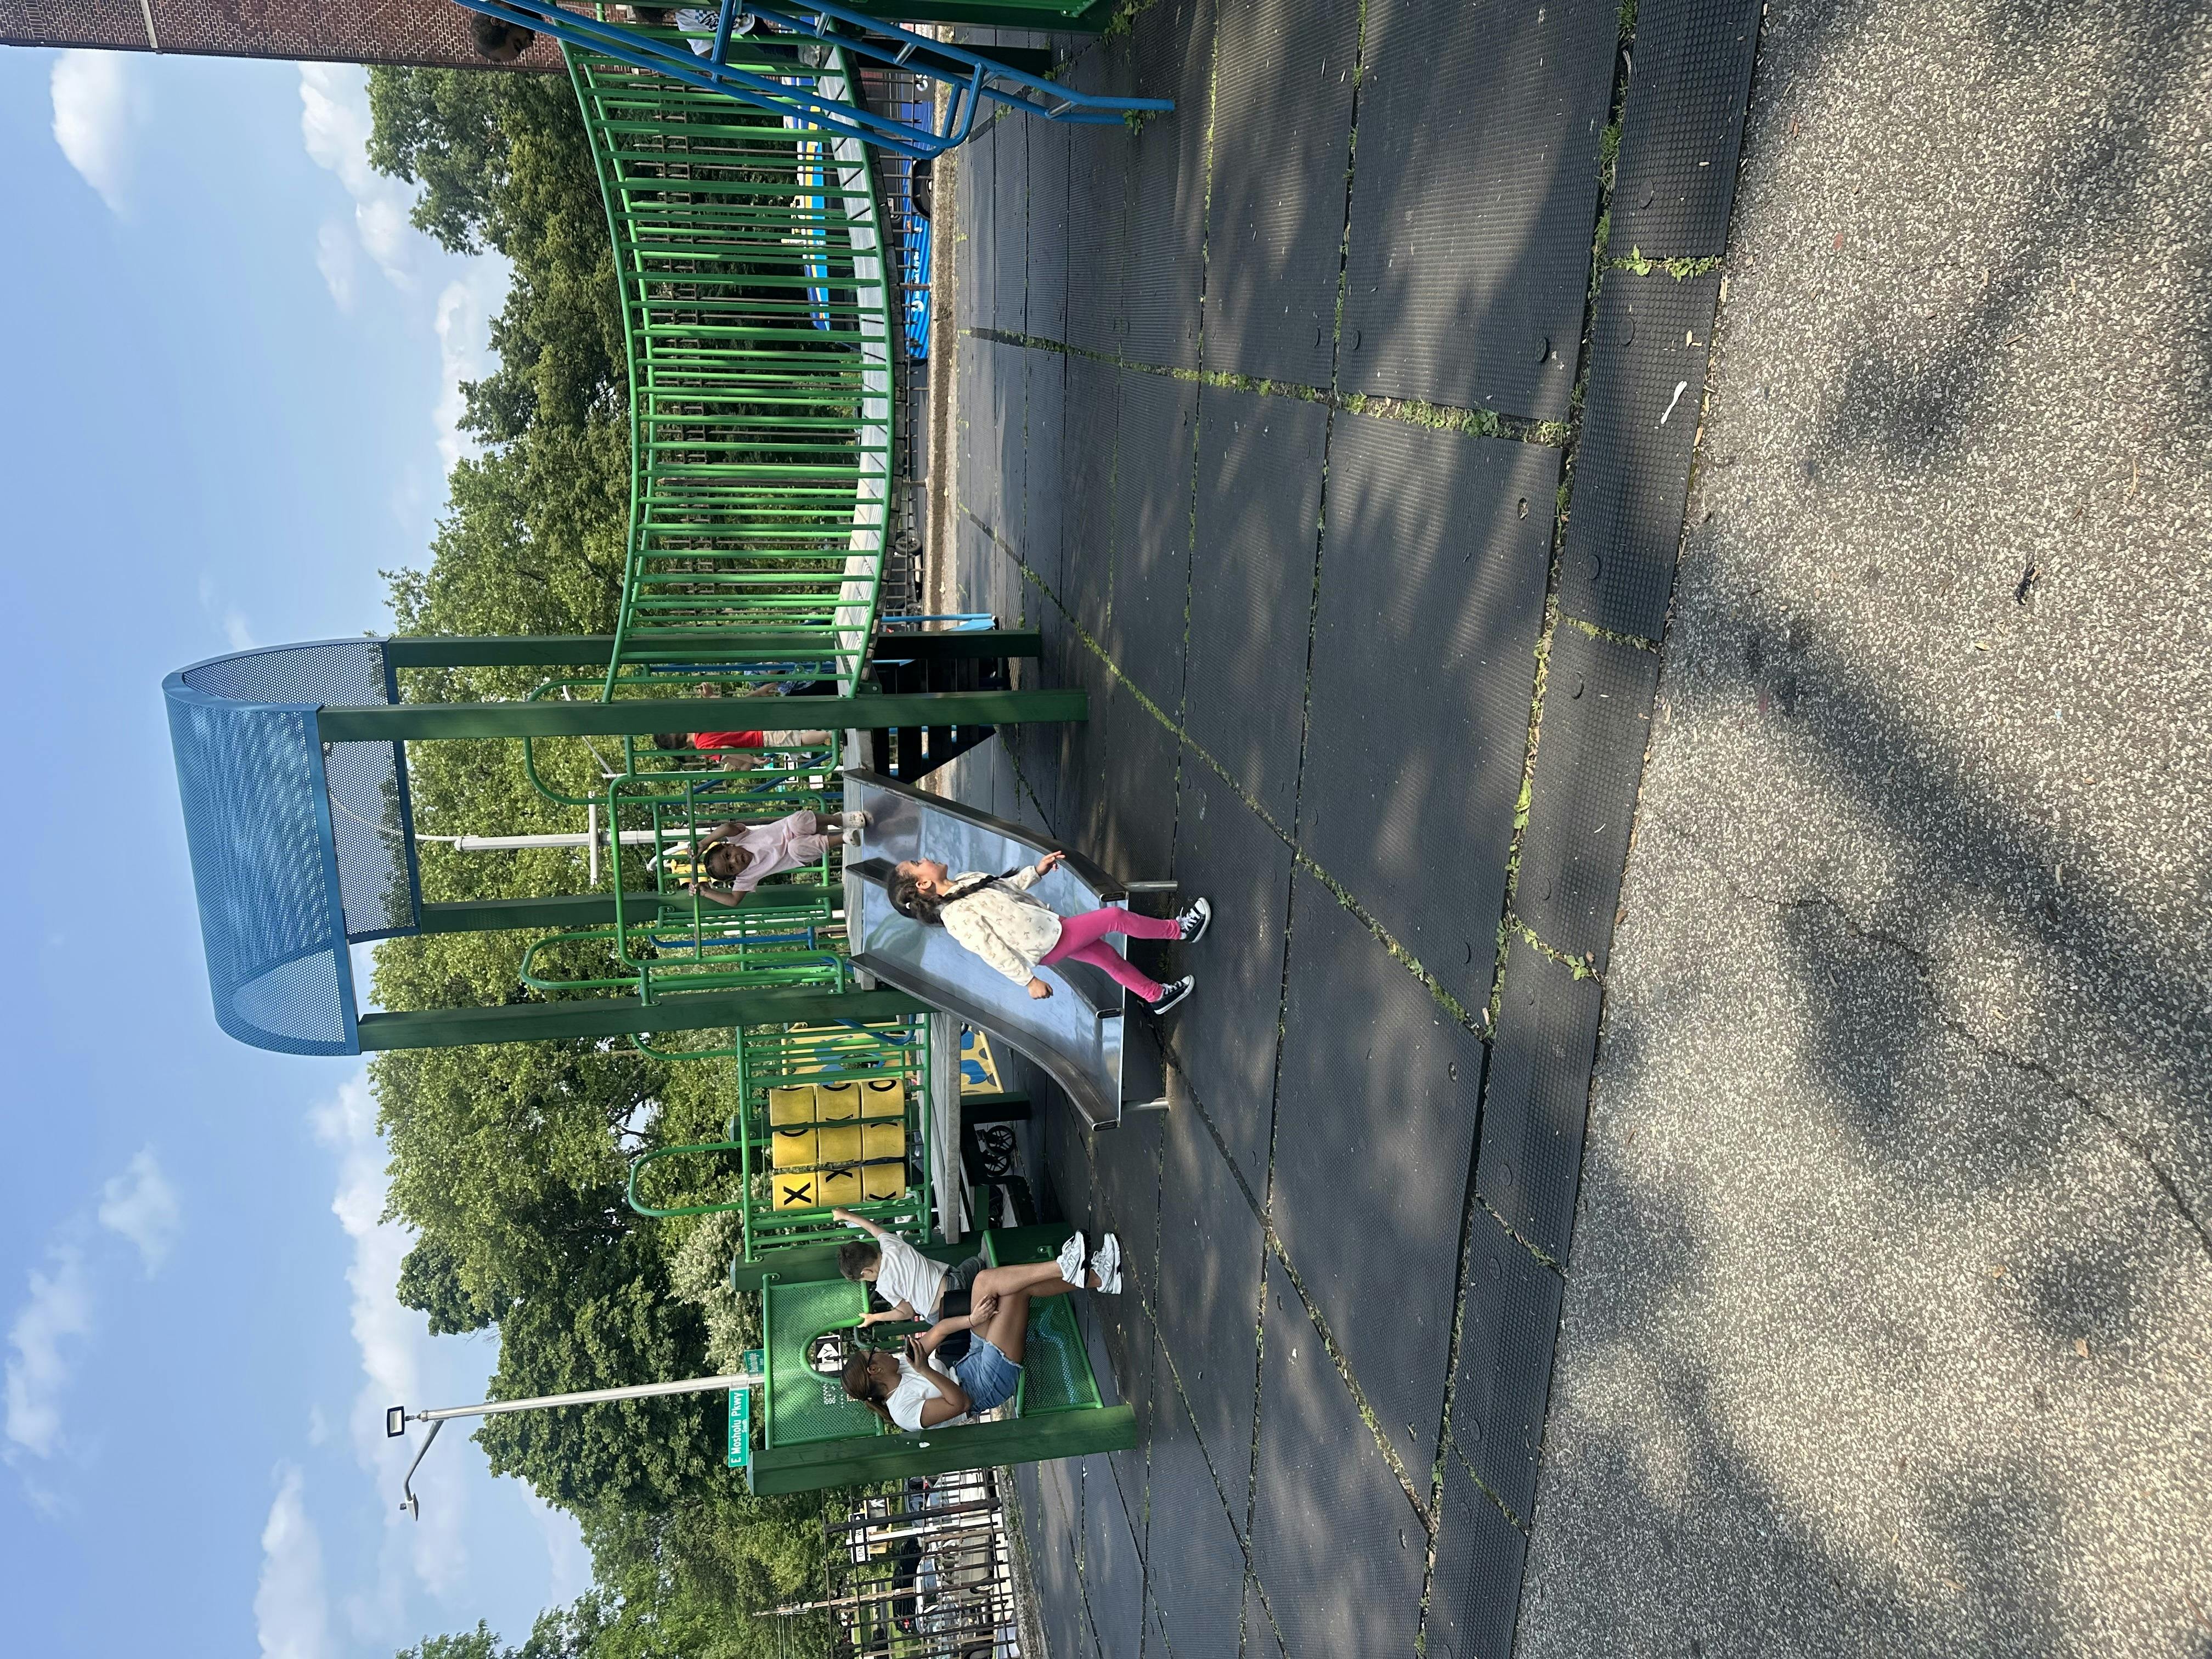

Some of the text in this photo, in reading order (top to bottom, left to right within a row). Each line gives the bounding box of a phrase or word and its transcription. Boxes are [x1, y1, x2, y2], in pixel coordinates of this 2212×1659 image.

[783, 1182, 811, 1206] X
[1068, 1256, 1076, 1267] N
[1104, 1260, 1111, 1271] N
[731, 1392, 744, 1417] Pkwy
[731, 1419, 742, 1454] Mosholu
